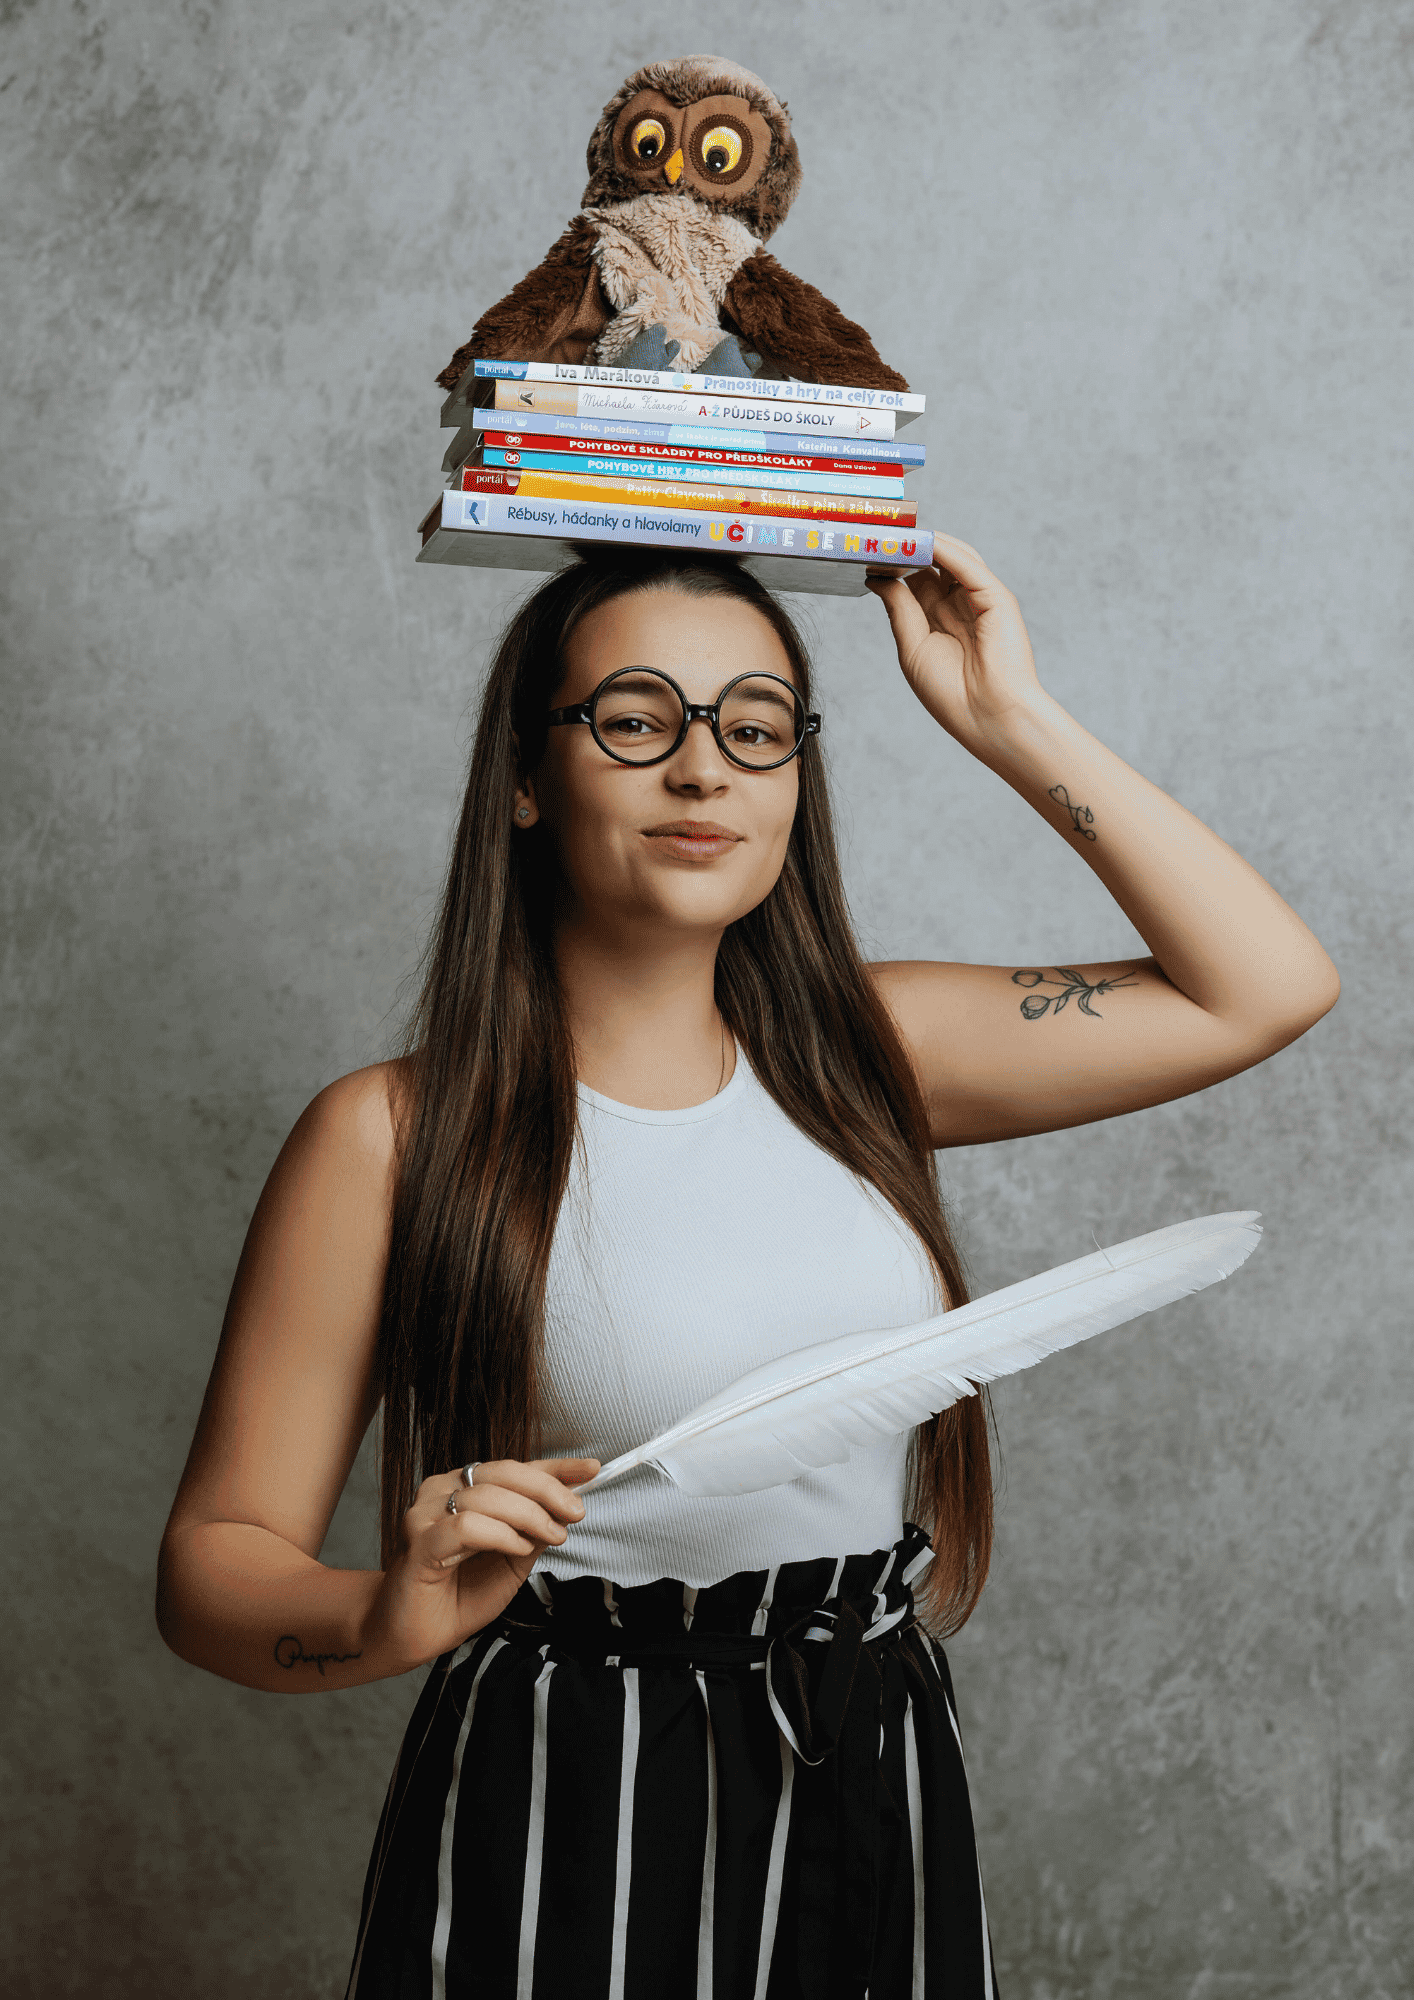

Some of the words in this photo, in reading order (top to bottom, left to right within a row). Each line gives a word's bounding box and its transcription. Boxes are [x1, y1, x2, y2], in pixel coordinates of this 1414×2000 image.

[484, 365, 509, 375] portál
[555, 364, 577, 379] Iva
[583, 367, 660, 385] Maráková
[582, 392, 636, 410] Michaela
[704, 376, 780, 397] Pranostiky
[785, 386, 794, 396] a
[796, 384, 822, 400] hry
[826, 389, 843, 400] na
[847, 388, 876, 406] celý
[880, 393, 904, 407] rok
[487, 414, 512, 425] portál
[723, 404, 771, 422] PŮJDEŠ
[774, 411, 793, 423] DO
[796, 410, 835, 426] ŠKOLY
[604, 424, 641, 436] podzim,
[643, 428, 665, 437] zima
[569, 439, 636, 453] POHYBOVÉ
[639, 446, 694, 458] SKLADBY
[698, 450, 723, 460] PRO
[725, 452, 813, 467] PŘEDŠKOLÁKY
[797, 440, 838, 453] Kateřina
[843, 445, 901, 458] Konvalinová
[587, 459, 655, 475] POHYBOVÉ
[657, 465, 682, 476] HRY
[686, 467, 710, 479] PRO
[713, 467, 801, 486] PŘEDŠKOLÁKY
[833, 462, 853, 470] Dana
[476, 474, 503, 484] portál
[760, 489, 809, 510] Školka
[813, 496, 846, 513] plná
[849, 500, 901, 520] zábavy
[507, 506, 558, 526] Rébusy,
[562, 510, 619, 531] hádanky
[622, 518, 630, 529] a
[634, 515, 701, 537] hlavolamy
[708, 518, 795, 548] UČÍME
[806, 530, 835, 551] SE
[843, 533, 917, 557] HROU
